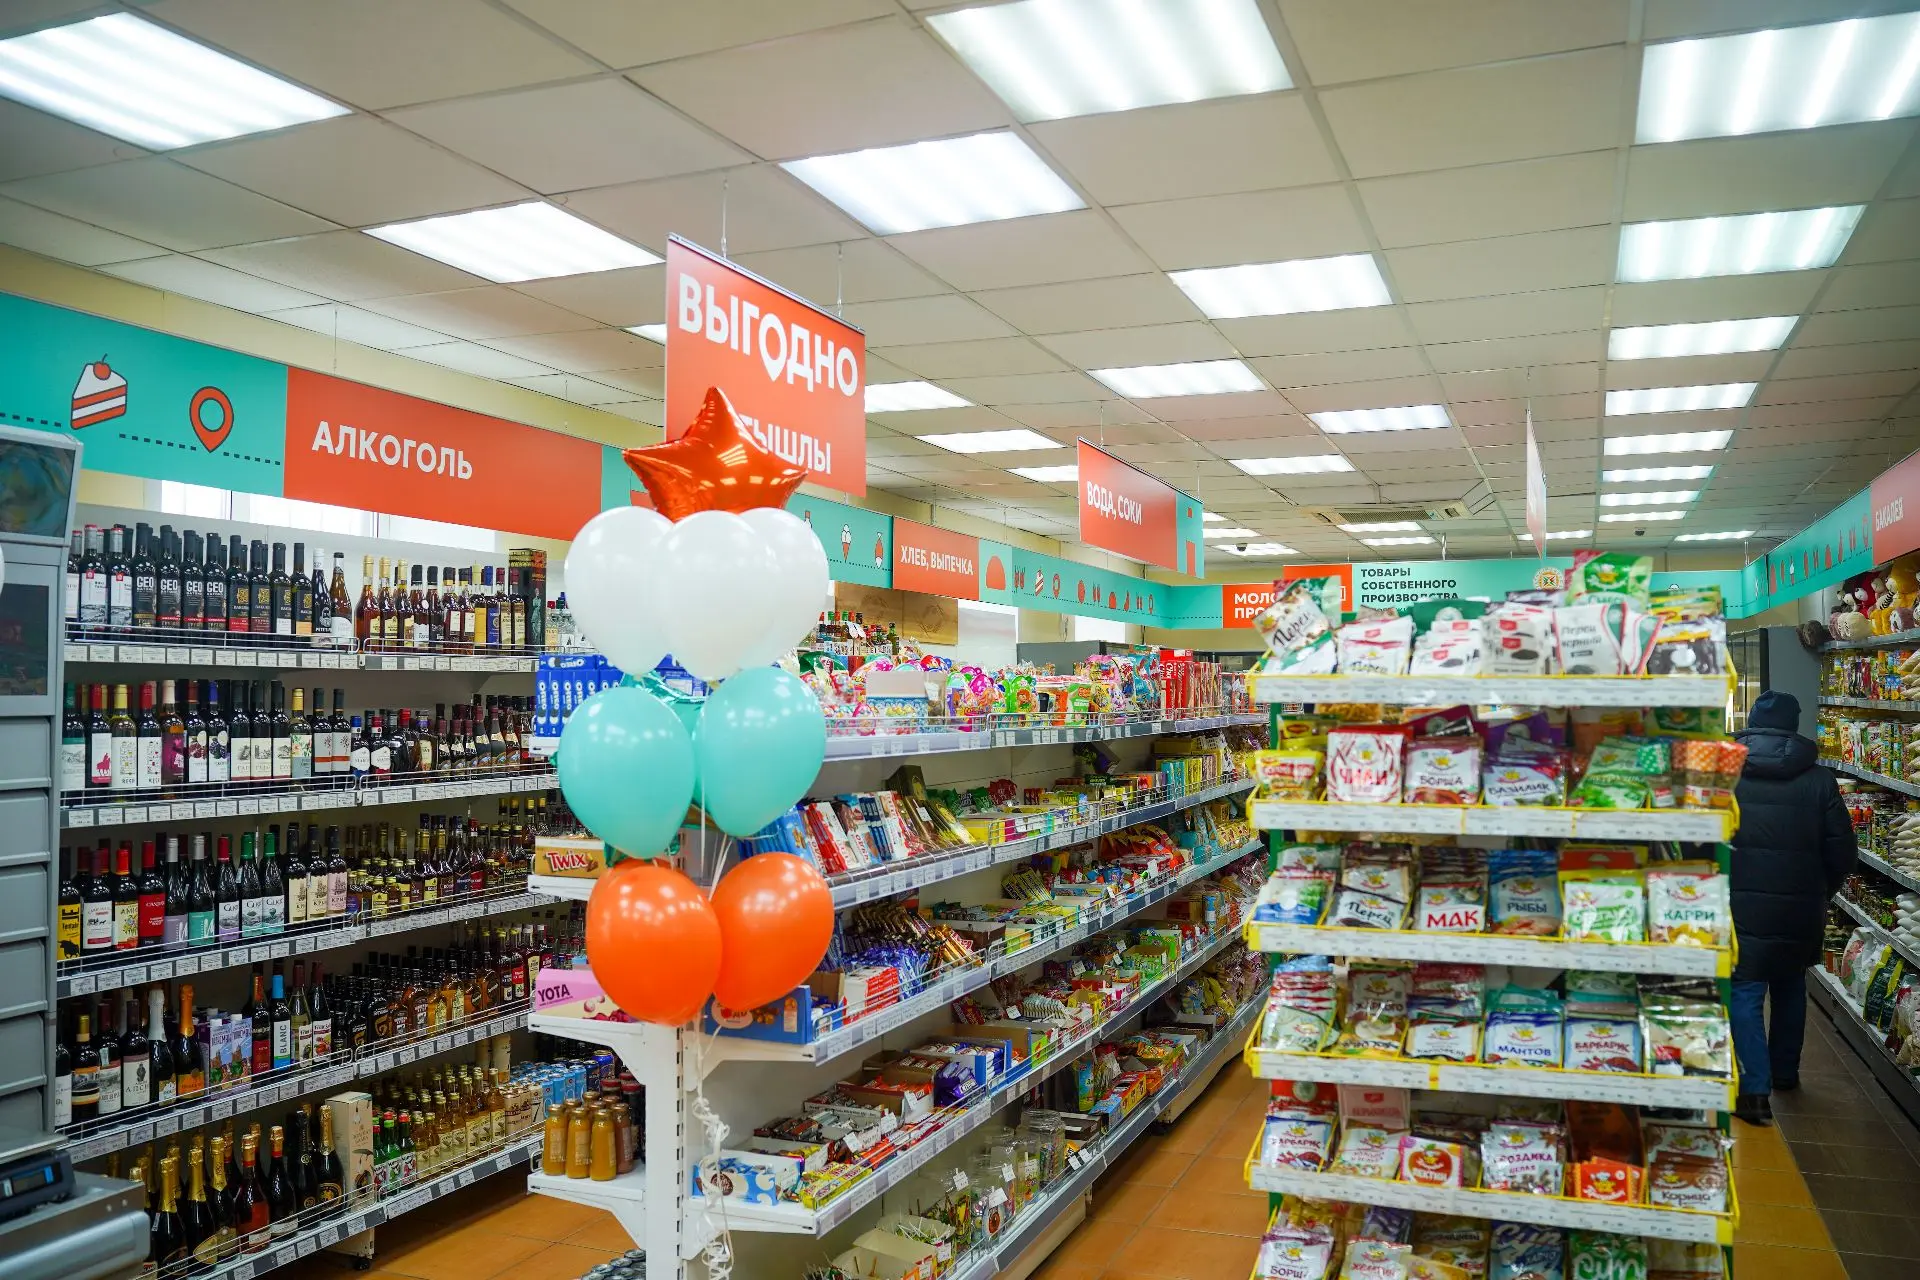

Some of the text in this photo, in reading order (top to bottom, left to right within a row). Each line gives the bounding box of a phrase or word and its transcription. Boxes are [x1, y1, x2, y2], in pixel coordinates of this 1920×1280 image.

[679, 272, 858, 397] ВЫГОДНО
[312, 420, 473, 480] АЛКОГОЛЬ
[1087, 480, 1142, 526] ВОДА, СОКИ
[1875, 496, 1904, 532] БАКАЛЕЯ
[900, 545, 974, 576] ХЛЕБ, ВЫПЕЧКА
[1360, 567, 1411, 578] ТОВАРЫ
[136, 576, 154, 588] GEO
[160, 579, 178, 591] GEO
[186, 581, 203, 593] GEO
[206, 581, 224, 593] GEO
[1360, 579, 1457, 591] СОБСТВЕННОГО
[546, 851, 590, 872] Twix
[1343, 900, 1393, 928] Перец
[1507, 902, 1548, 914] РЫБЫ
[1663, 908, 1716, 922] КАРРИ
[1426, 910, 1480, 929] МАК
[538, 984, 571, 1003] YOTA
[277, 1025, 288, 1056] BLANC
[1498, 1045, 1553, 1058] МАНТОВ
[1661, 1190, 1711, 1205] Корица
